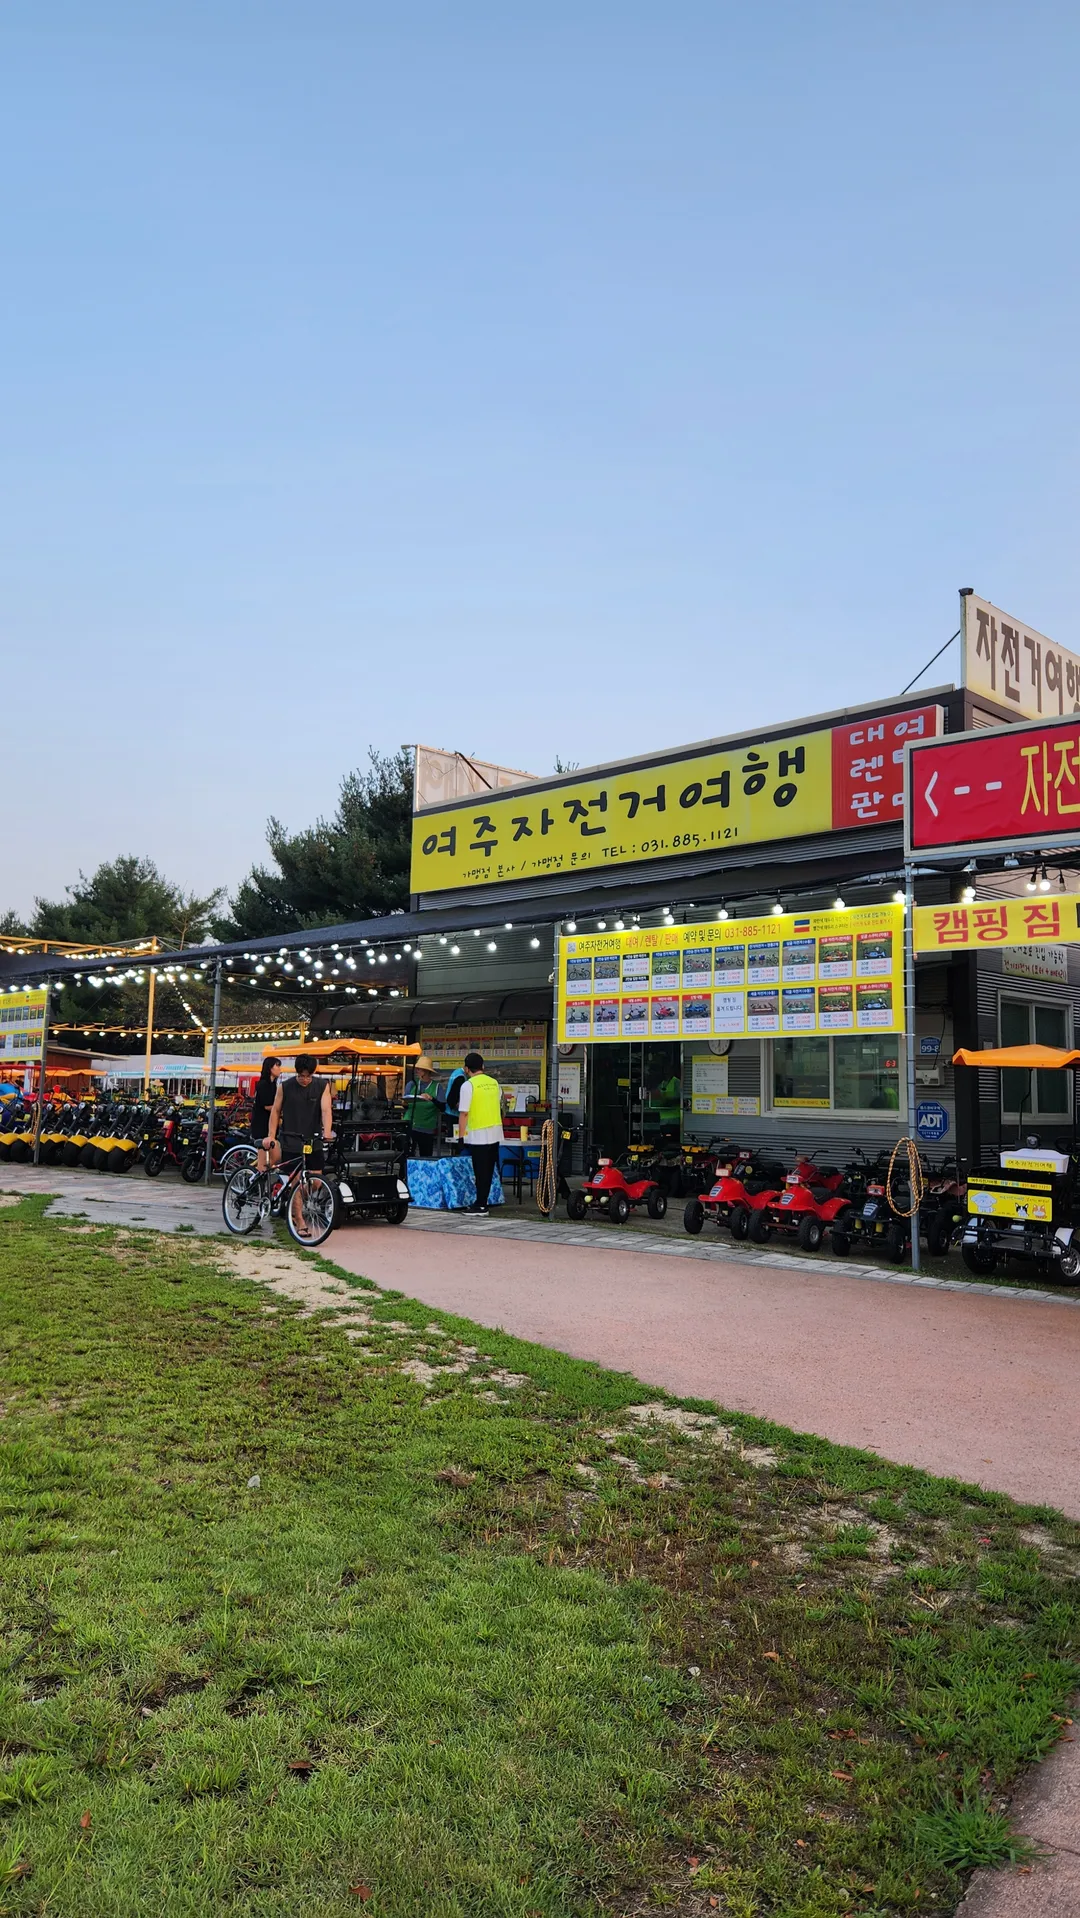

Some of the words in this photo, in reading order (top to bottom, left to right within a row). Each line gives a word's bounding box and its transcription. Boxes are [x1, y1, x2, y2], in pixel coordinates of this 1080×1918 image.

[850, 715, 924, 746] 대여
[421, 745, 806, 857] 여주자전거여행
[570, 851, 592, 866] 문의
[640, 827, 739, 854] 031.885.1121
[578, 938, 620, 952] 여주자전거여행
[626, 936, 639, 947] 대여
[644, 935, 658, 946] 렌탈
[683, 930, 697, 942] 예약
[698, 928, 705, 942] 및
[707, 926, 722, 942] 문의
[725, 924, 782, 938] 031-885-1121
[933, 906, 1009, 944] 캠핑
[1023, 902, 1061, 938] 짐
[919, 1114, 942, 1128] ADT
